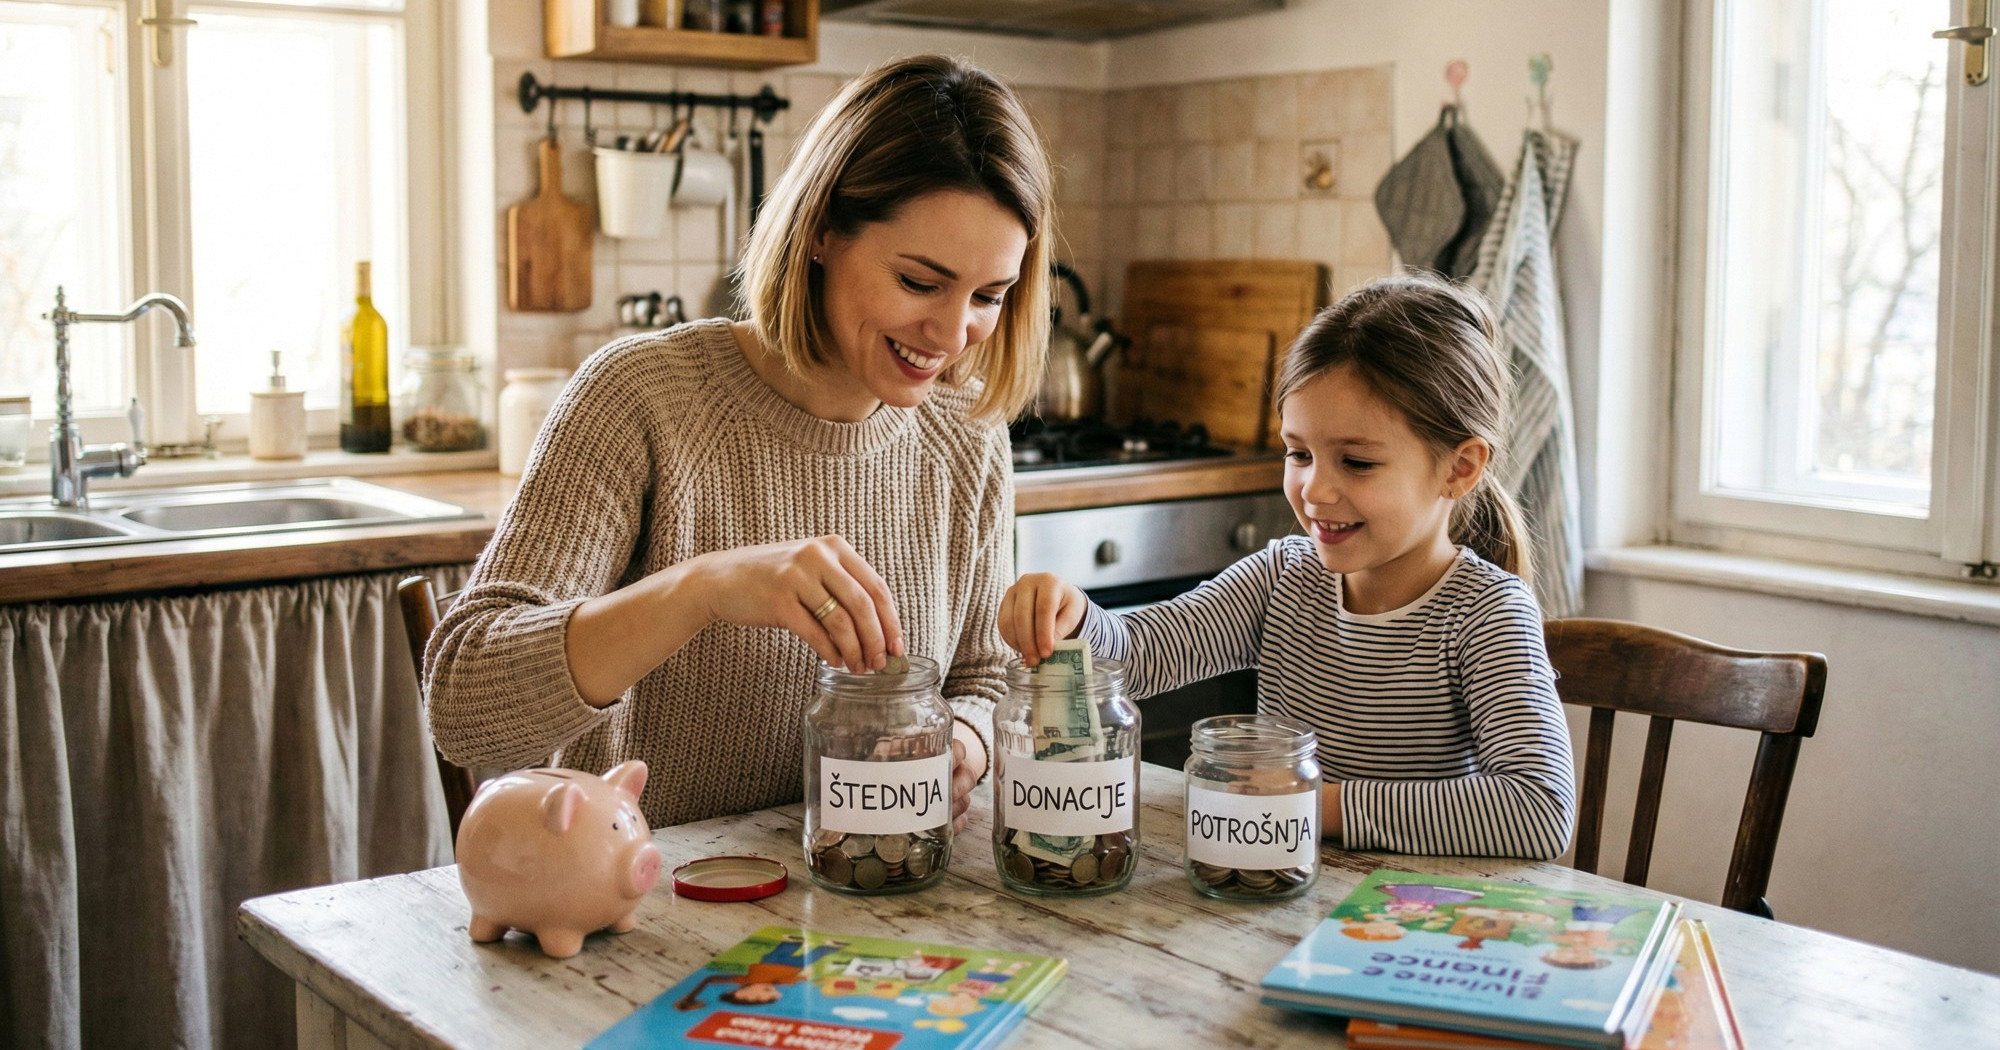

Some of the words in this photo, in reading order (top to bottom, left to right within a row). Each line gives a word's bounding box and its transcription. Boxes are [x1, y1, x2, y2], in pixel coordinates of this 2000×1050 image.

[828, 772, 943, 818] ŠTEDNJA
[1012, 779, 1127, 820] DONACIJE
[1190, 809, 1312, 854] POTROŠNJA
